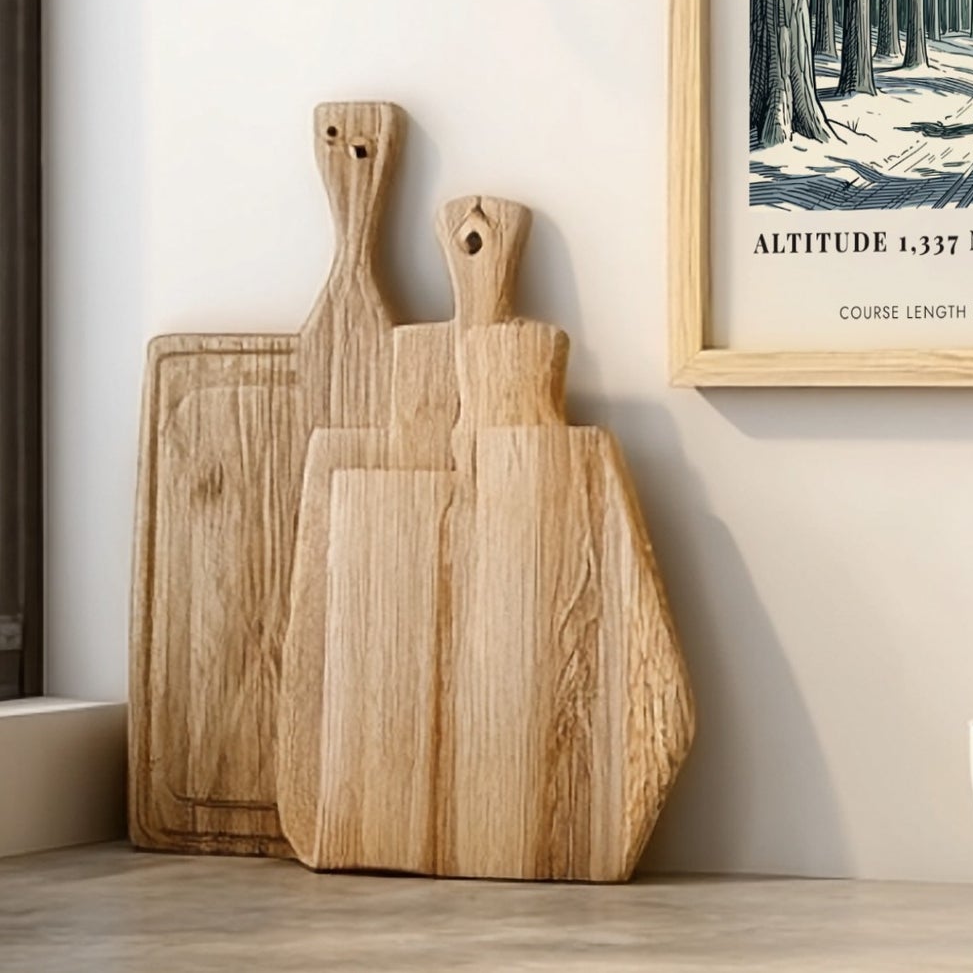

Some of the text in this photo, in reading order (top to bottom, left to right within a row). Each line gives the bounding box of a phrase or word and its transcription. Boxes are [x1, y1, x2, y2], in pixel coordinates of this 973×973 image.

[754, 232, 886, 254] ALTITUDE
[900, 235, 958, 255] 1,337
[840, 306, 899, 320] COURSE
[907, 305, 966, 319] LENGTH
